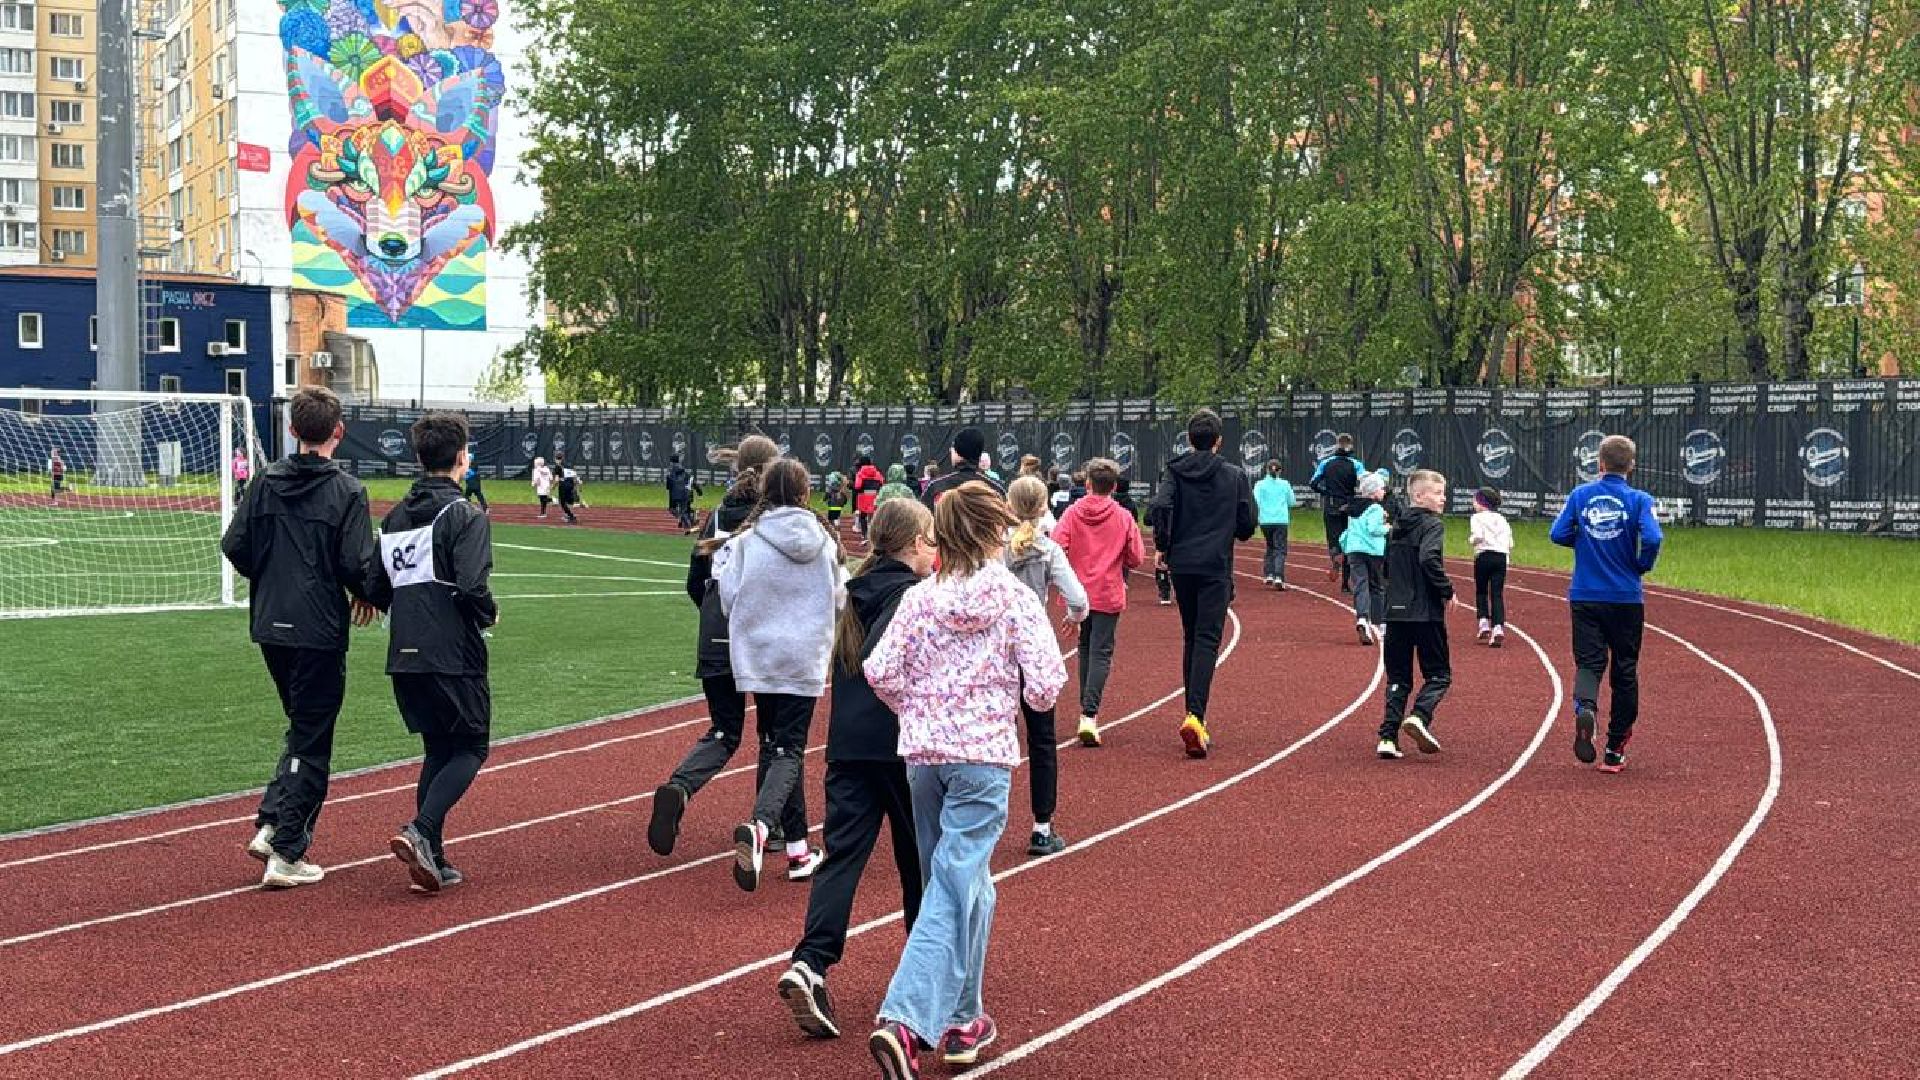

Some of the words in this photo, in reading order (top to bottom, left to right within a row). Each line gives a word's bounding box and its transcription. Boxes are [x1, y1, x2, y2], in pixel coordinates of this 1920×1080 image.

[1768, 383, 1817, 392] БАЛАШИХА
[1833, 381, 1885, 391] БАЛАШИХА
[1833, 391, 1885, 401] ВЫБИРАЕТ
[1710, 405, 1738, 414] СПОРТ
[1768, 404, 1798, 413] СПОРТ
[1833, 402, 1861, 412] СПОРТ
[392, 543, 418, 572] 82
